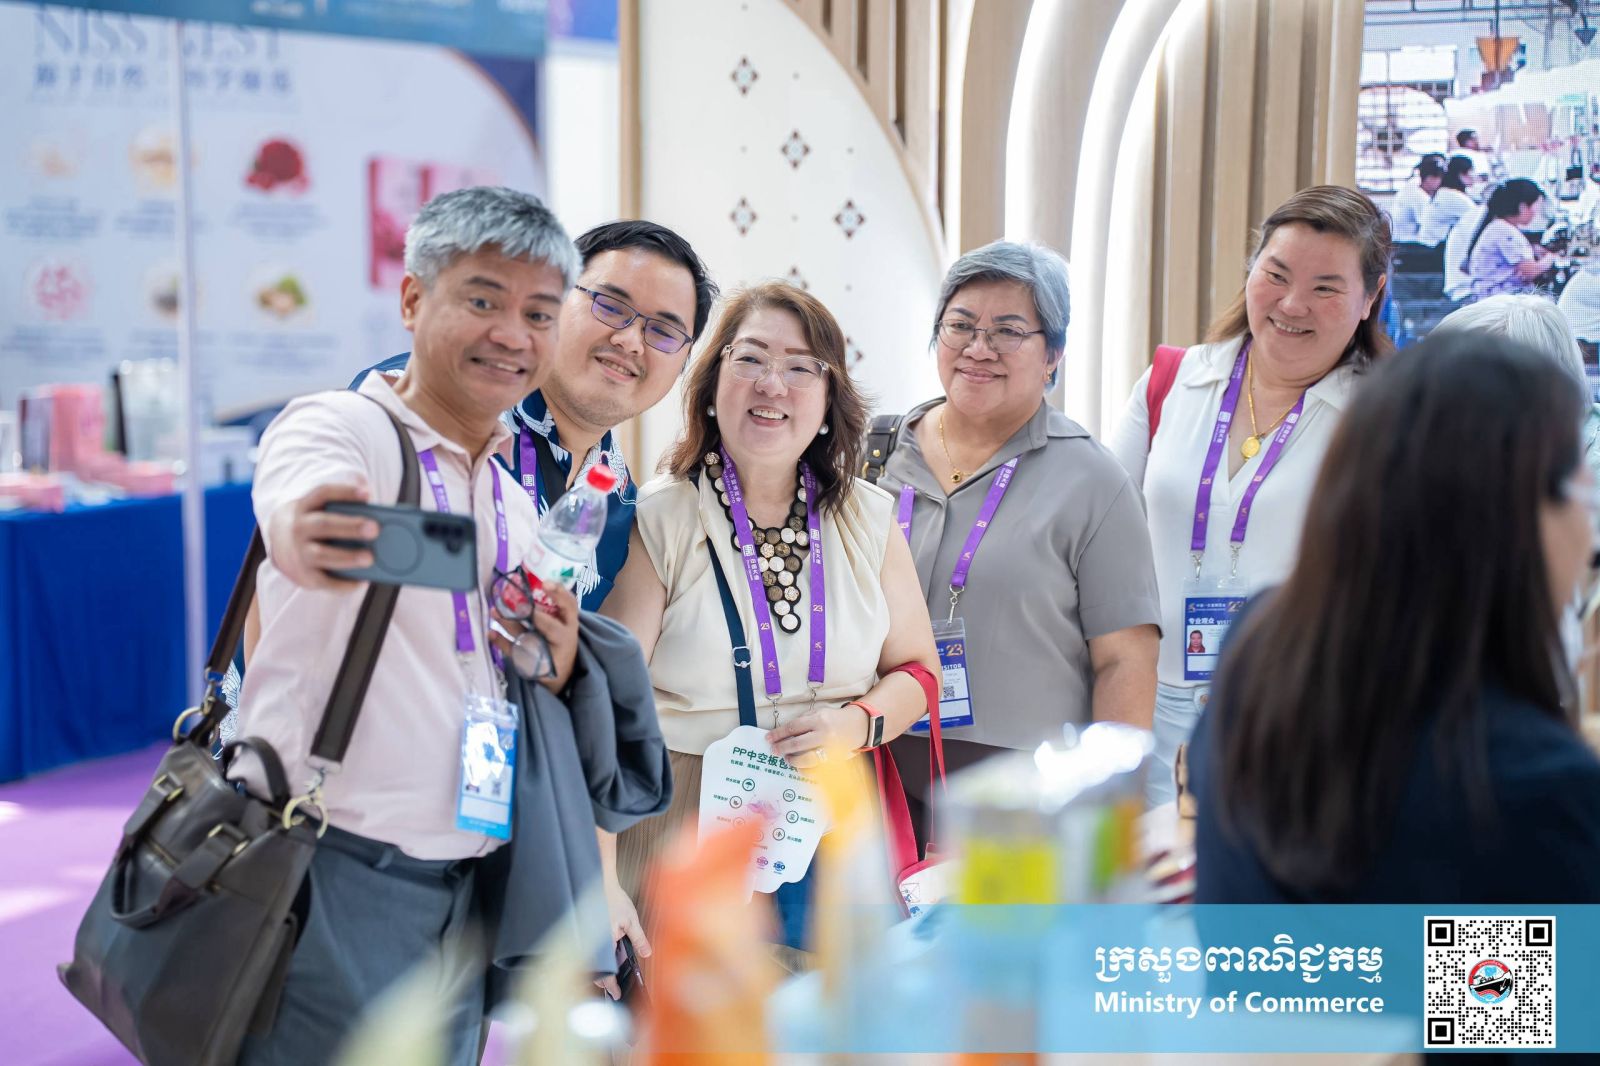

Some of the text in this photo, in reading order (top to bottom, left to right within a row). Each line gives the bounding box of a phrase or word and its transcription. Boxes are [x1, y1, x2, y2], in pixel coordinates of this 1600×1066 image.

[812, 604, 823, 612] 23
[760, 622, 769, 630] 23
[945, 643, 963, 657] 23
[942, 663, 962, 671] ISITOR
[773, 862, 786, 870] ISO
